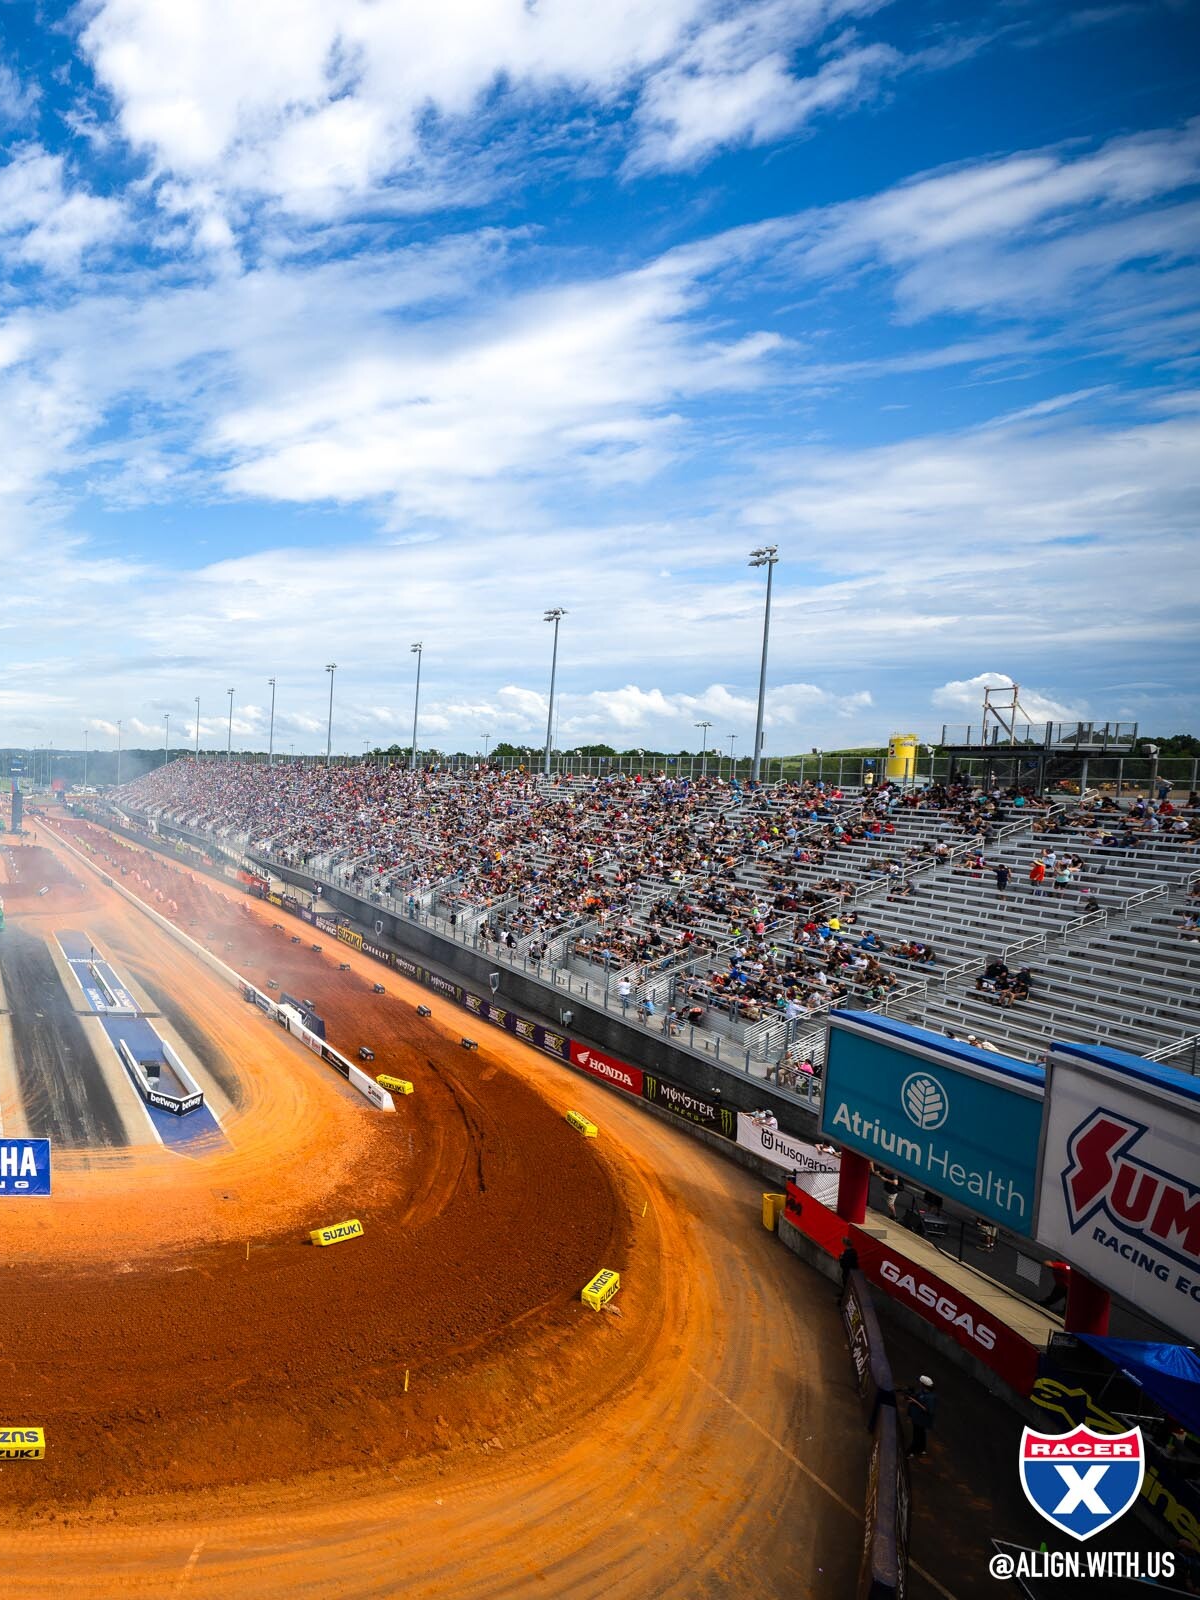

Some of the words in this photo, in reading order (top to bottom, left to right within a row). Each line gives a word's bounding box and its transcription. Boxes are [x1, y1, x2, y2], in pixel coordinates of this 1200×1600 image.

[338, 928, 361, 949] SUZUKI
[589, 1057, 633, 1087] HONDA
[150, 1094, 180, 1112] betway
[181, 1095, 201, 1111] betway
[660, 1084, 716, 1119] MONSTER
[667, 1102, 706, 1123] ENERGY
[833, 1102, 922, 1166] Atrium
[774, 1137, 834, 1172] Husqvarna
[927, 1143, 1025, 1217] Health
[322, 1223, 361, 1241] SUZUKI
[1092, 1226, 1170, 1283] RACING
[587, 1270, 615, 1295] SUZUKI
[880, 1260, 997, 1351] GASGAS
